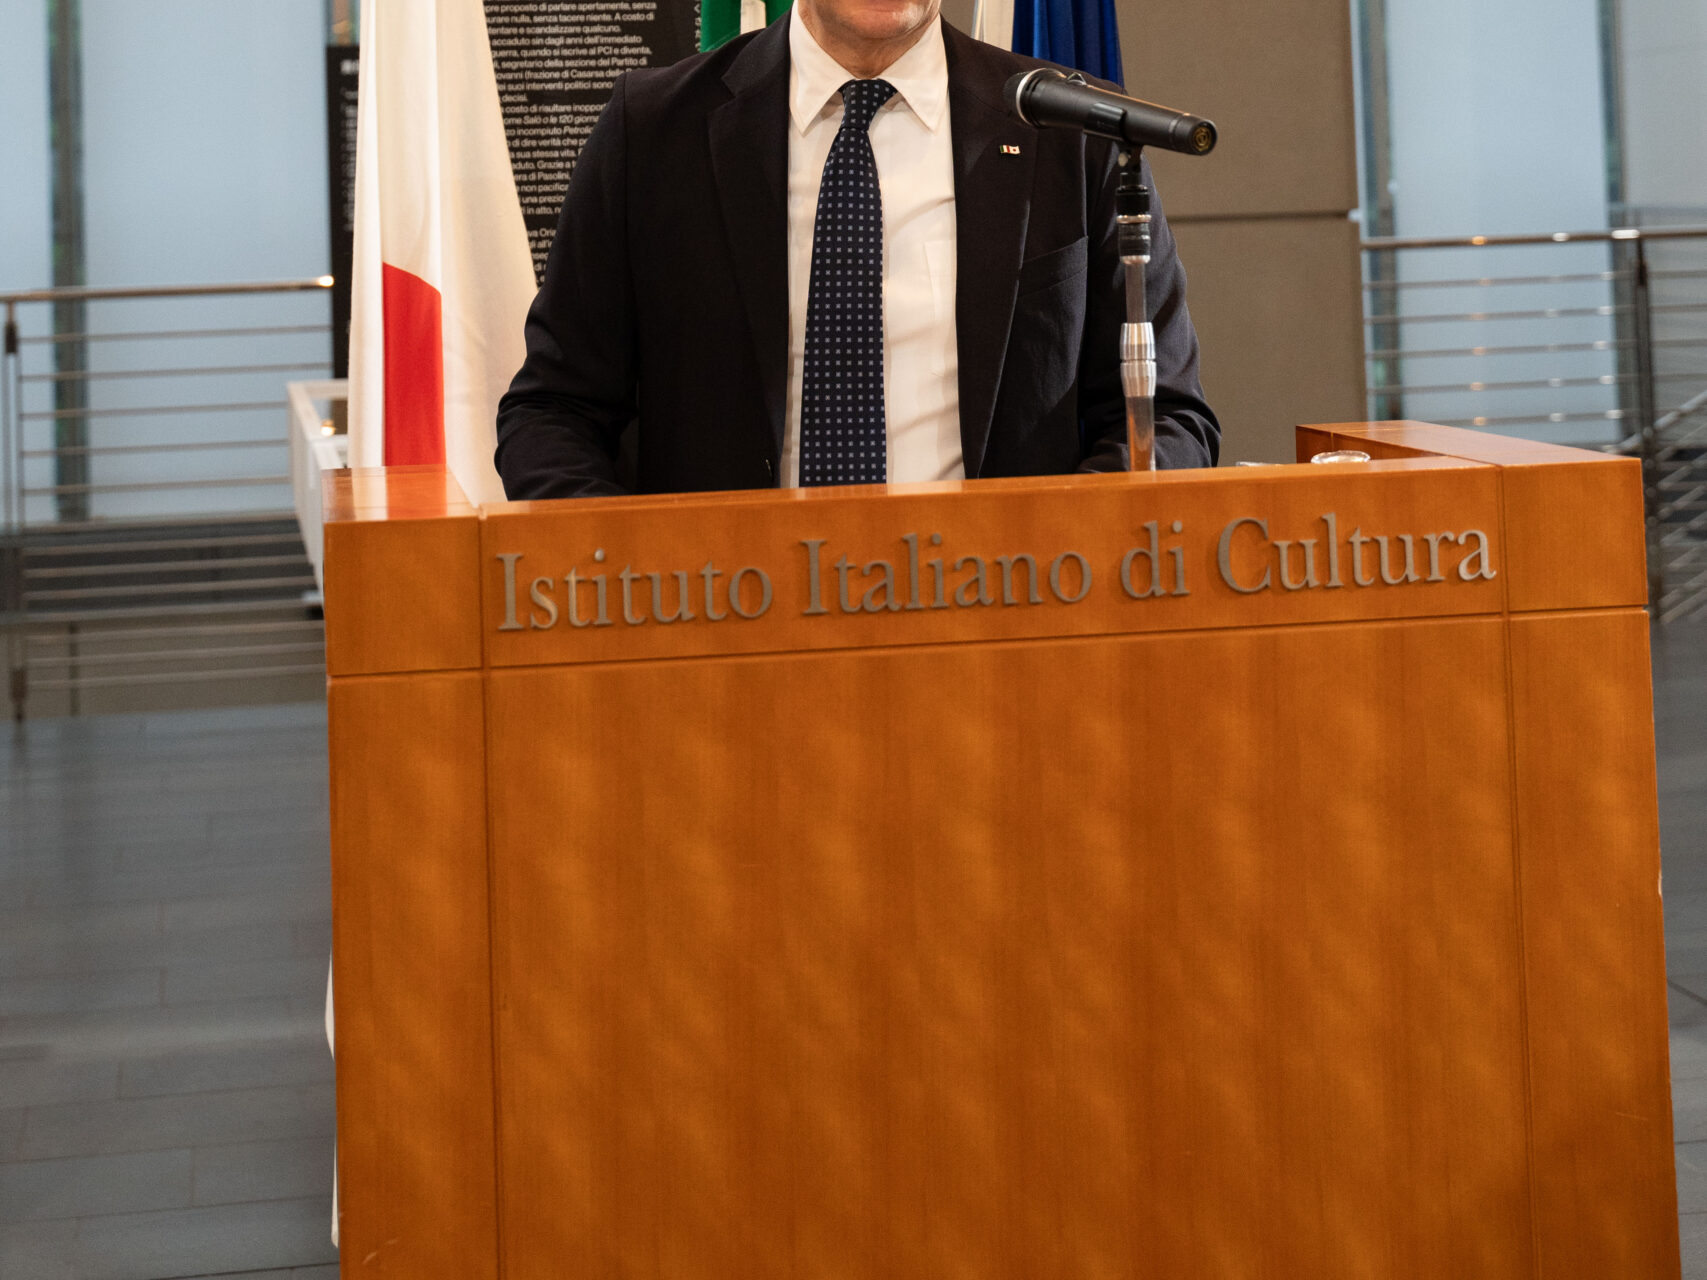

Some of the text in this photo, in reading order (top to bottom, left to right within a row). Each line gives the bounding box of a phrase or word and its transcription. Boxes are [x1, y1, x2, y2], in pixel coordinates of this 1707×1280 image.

[484, 2, 657, 14] pre proposto di parlare apertamente, senza
[533, 15, 558, 23] senza
[614, 12, 621, 20] A
[622, 12, 645, 21] costo
[646, 11, 655, 20] di
[491, 37, 530, 46] accaduto
[520, 47, 551, 57] quando
[501, 60, 543, 69] segretario
[570, 68, 604, 78] Casarsa
[592, 81, 613, 89] sono
[505, 104, 529, 113] costo
[517, 126, 562, 136] incompiuto
[532, 149, 559, 159] stessa
[536, 159, 564, 169] Grazie
[520, 185, 537, 193] non
[496, 511, 1498, 631] Istituto Italiano di Cultura
